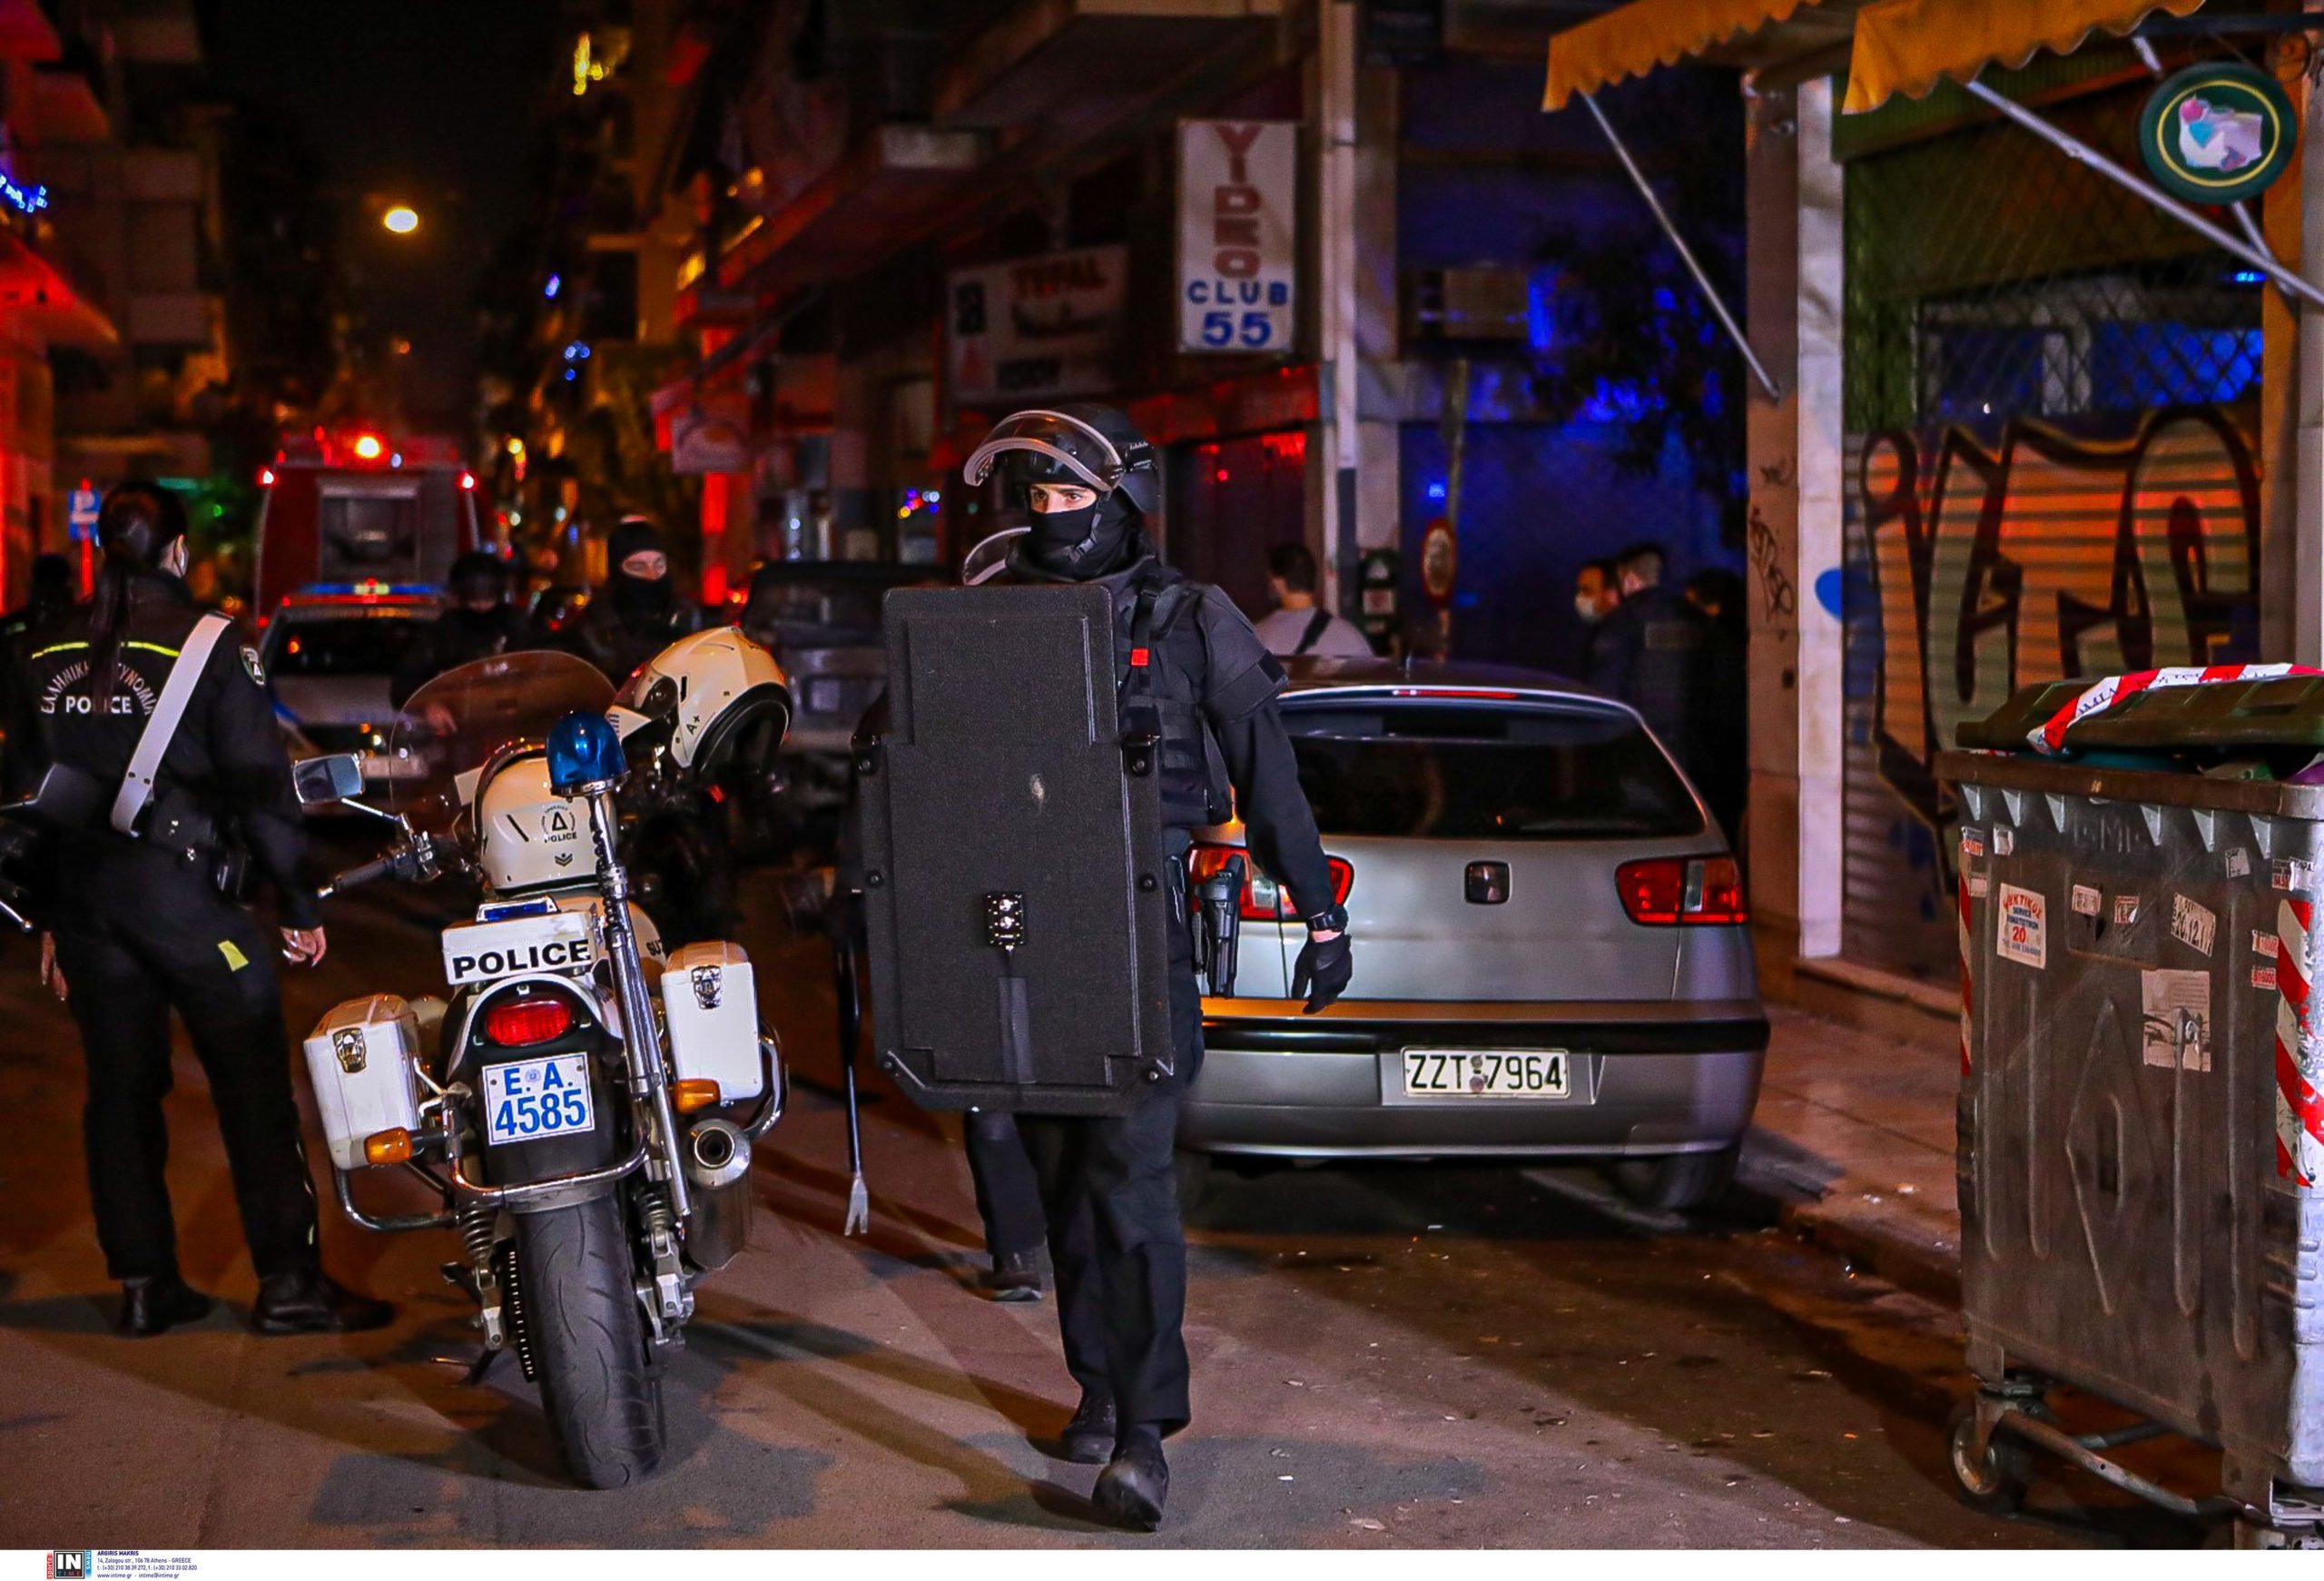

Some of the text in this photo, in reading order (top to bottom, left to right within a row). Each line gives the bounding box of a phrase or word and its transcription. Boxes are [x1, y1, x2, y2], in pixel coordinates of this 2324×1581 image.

[1187, 281, 1287, 305] CLUB
[1203, 311, 1271, 346] 55
[452, 939, 591, 979] POLICE
[1485, 1055, 1562, 1090] 7964
[495, 1089, 586, 1136] 4585
